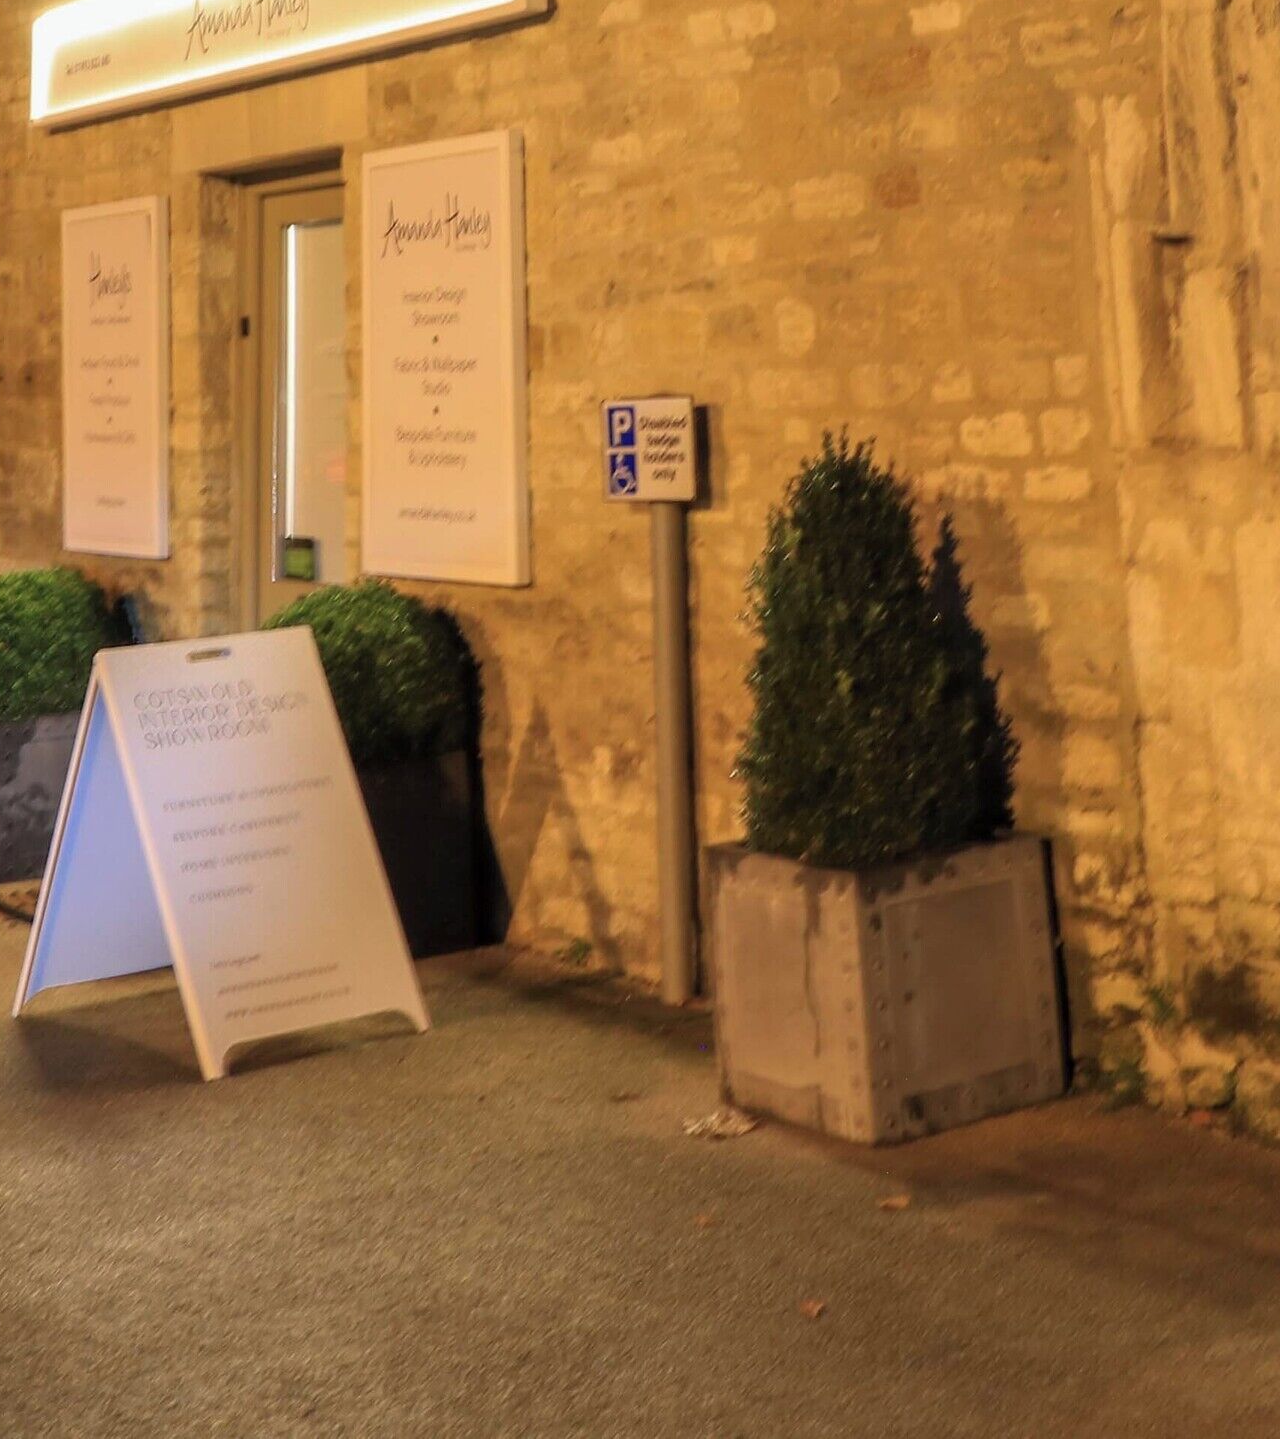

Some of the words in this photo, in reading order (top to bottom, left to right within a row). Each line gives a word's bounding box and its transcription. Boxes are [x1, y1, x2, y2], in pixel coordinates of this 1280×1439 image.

[381, 199, 442, 259] Amanda
[443, 192, 492, 250] Hanley
[611, 409, 632, 447] P
[652, 466, 677, 483] only
[133, 680, 254, 710] COTSWOLD
[137, 702, 230, 730] INTERIOR
[234, 691, 308, 717] DESIGN
[143, 717, 271, 750] SHOWROOM
